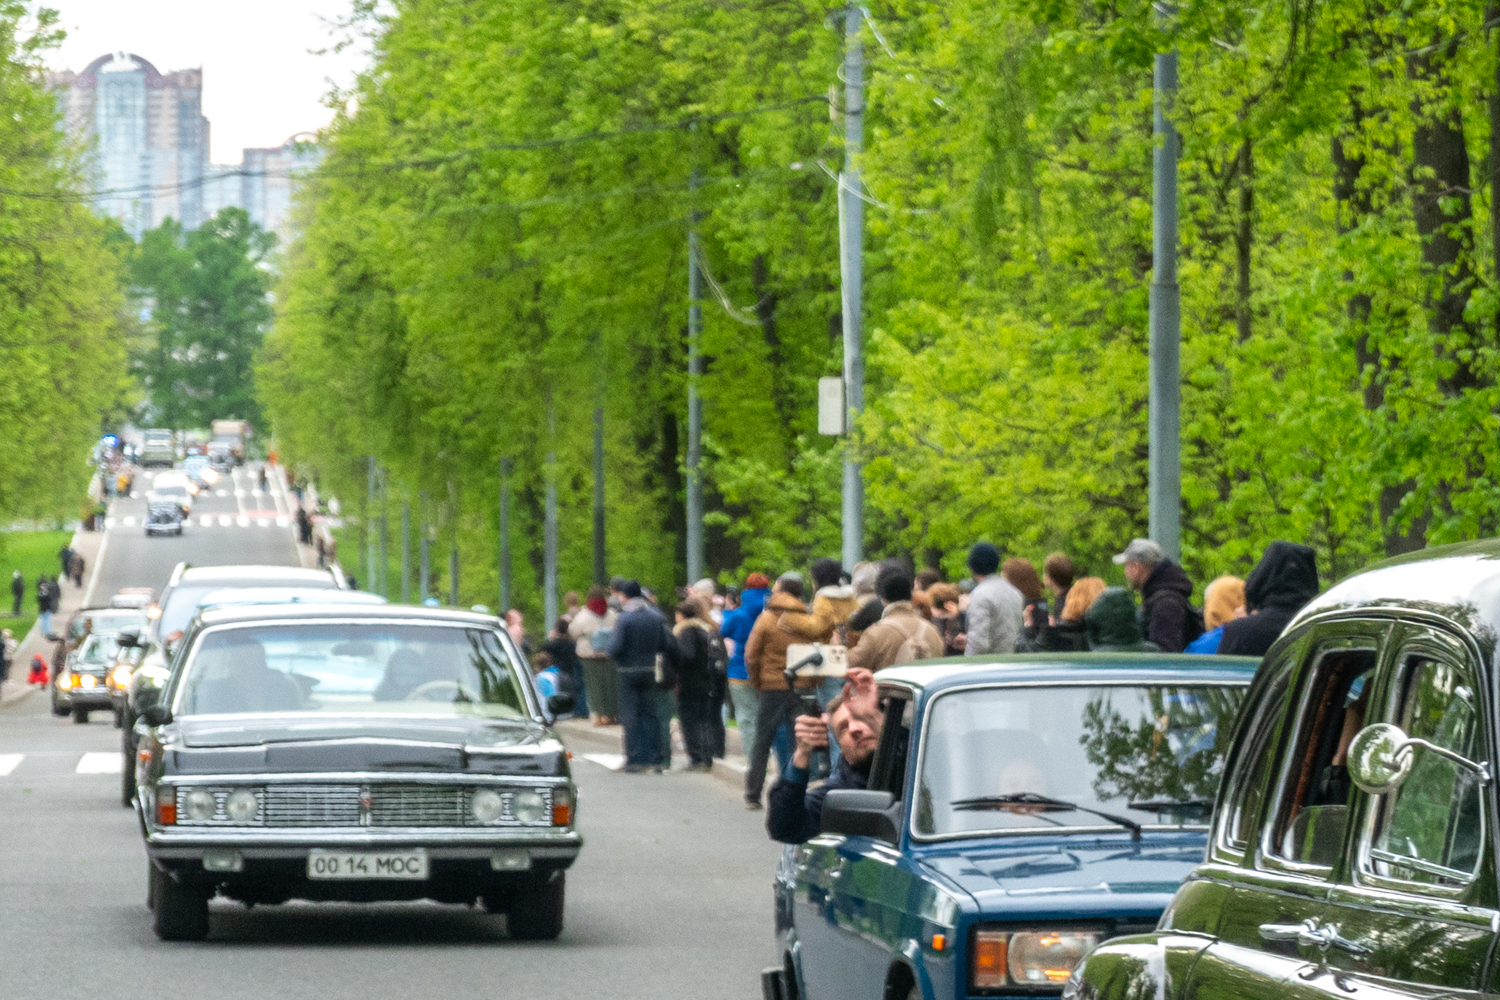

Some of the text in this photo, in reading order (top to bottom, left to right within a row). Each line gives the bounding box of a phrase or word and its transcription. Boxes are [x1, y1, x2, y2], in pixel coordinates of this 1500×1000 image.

[314, 857, 420, 874] 00 14 МОС
